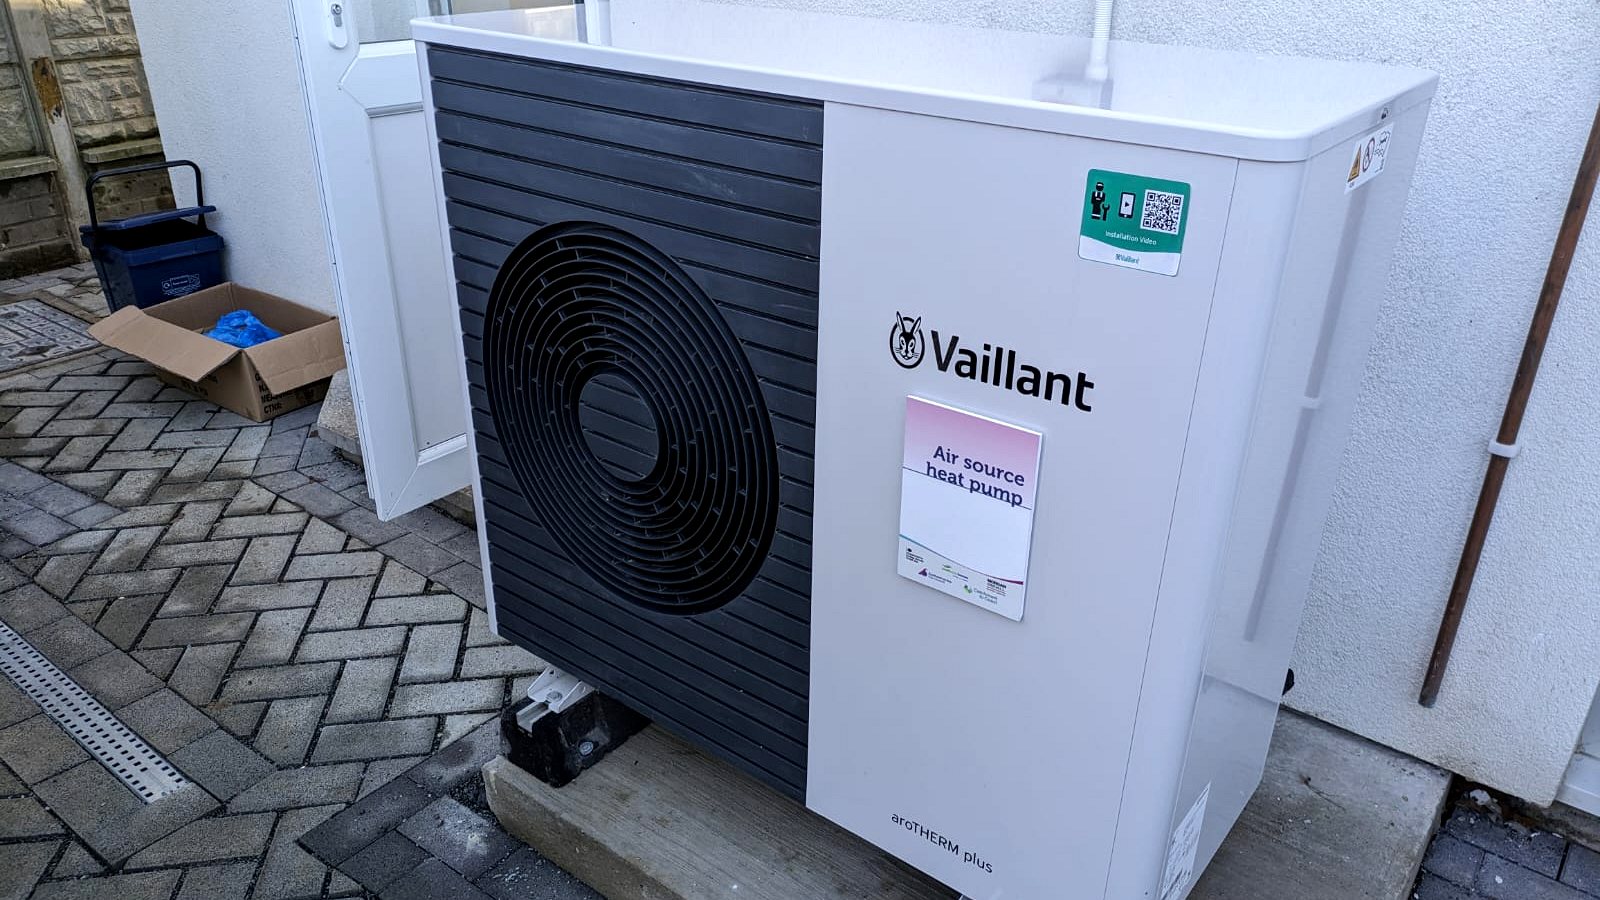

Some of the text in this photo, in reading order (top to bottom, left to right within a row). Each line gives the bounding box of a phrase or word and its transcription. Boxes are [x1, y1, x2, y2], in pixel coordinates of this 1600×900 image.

[1105, 230, 1157, 246] Installation Video
[931, 330, 1095, 412] Vaillant
[926, 461, 1023, 508] heat pump
[933, 445, 1025, 487] Air source
[891, 813, 993, 874] aroTHERM plus
